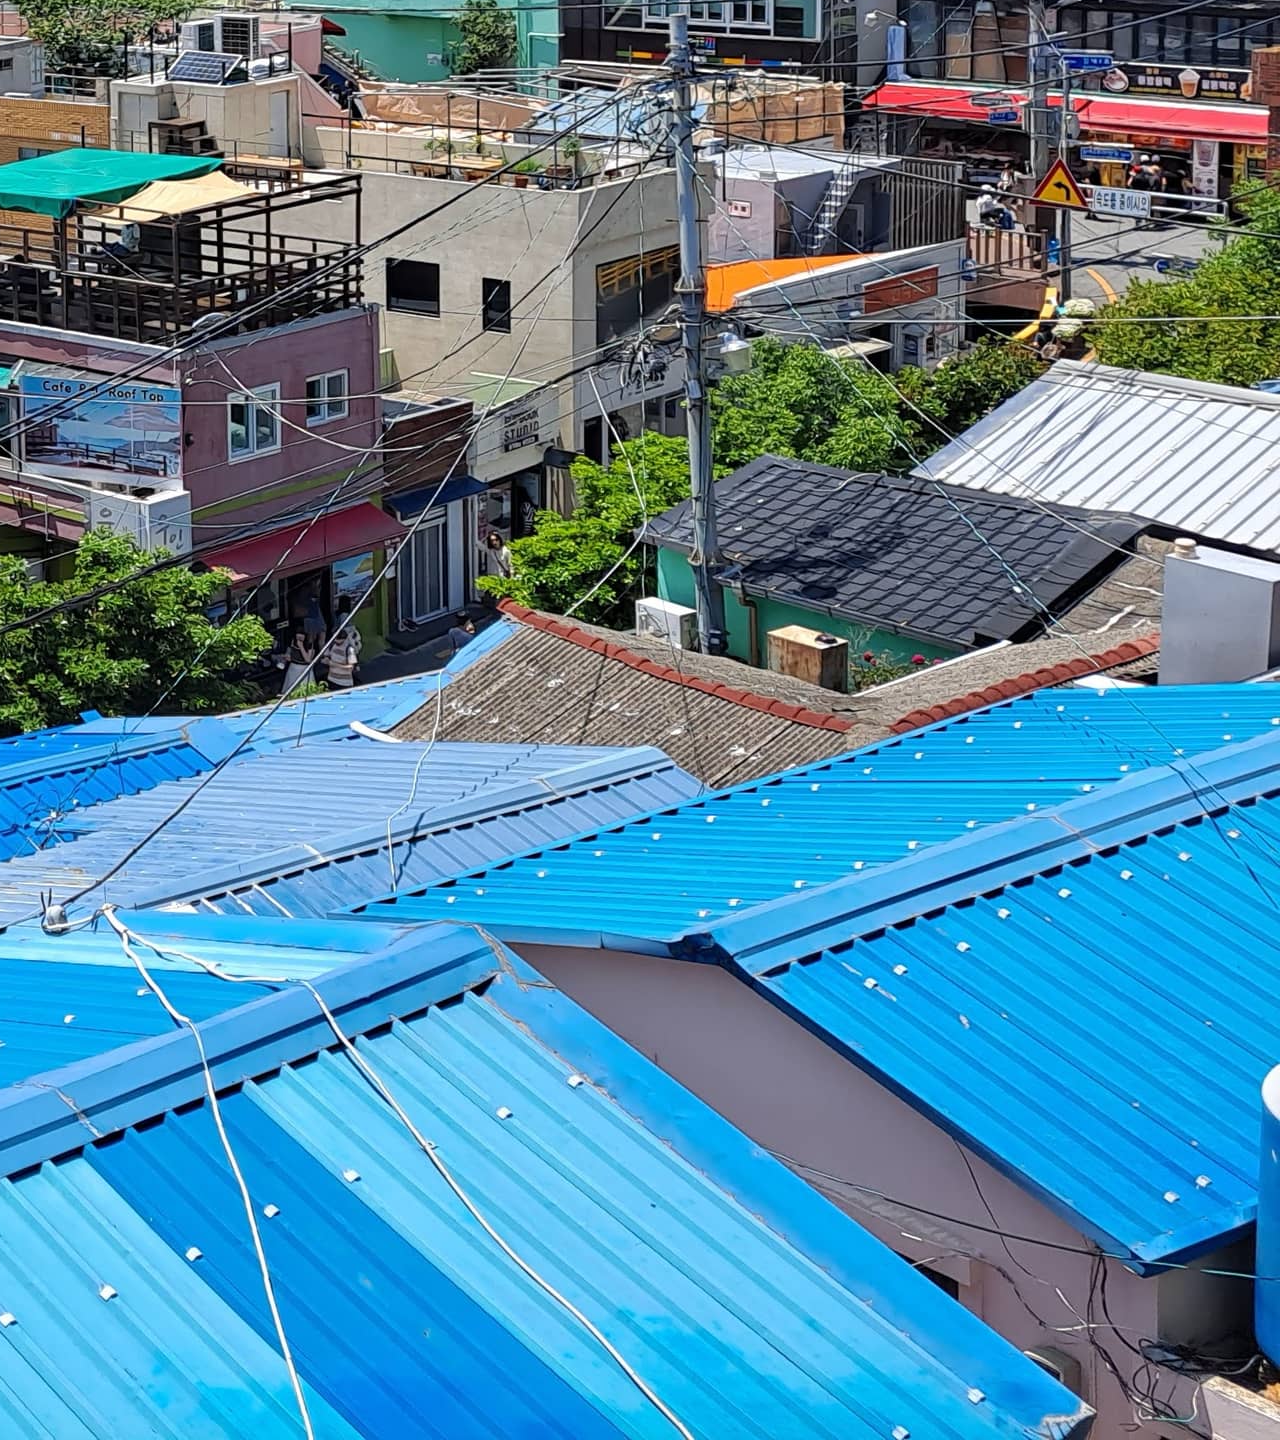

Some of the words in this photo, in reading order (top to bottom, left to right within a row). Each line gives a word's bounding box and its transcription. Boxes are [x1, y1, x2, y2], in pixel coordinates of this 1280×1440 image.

[1096, 191, 1117, 210] 속도를
[42, 380, 72, 393] Cafe
[108, 388, 137, 400] Roof
[141, 389, 164, 402] Top
[503, 420, 539, 442] STUDIO
